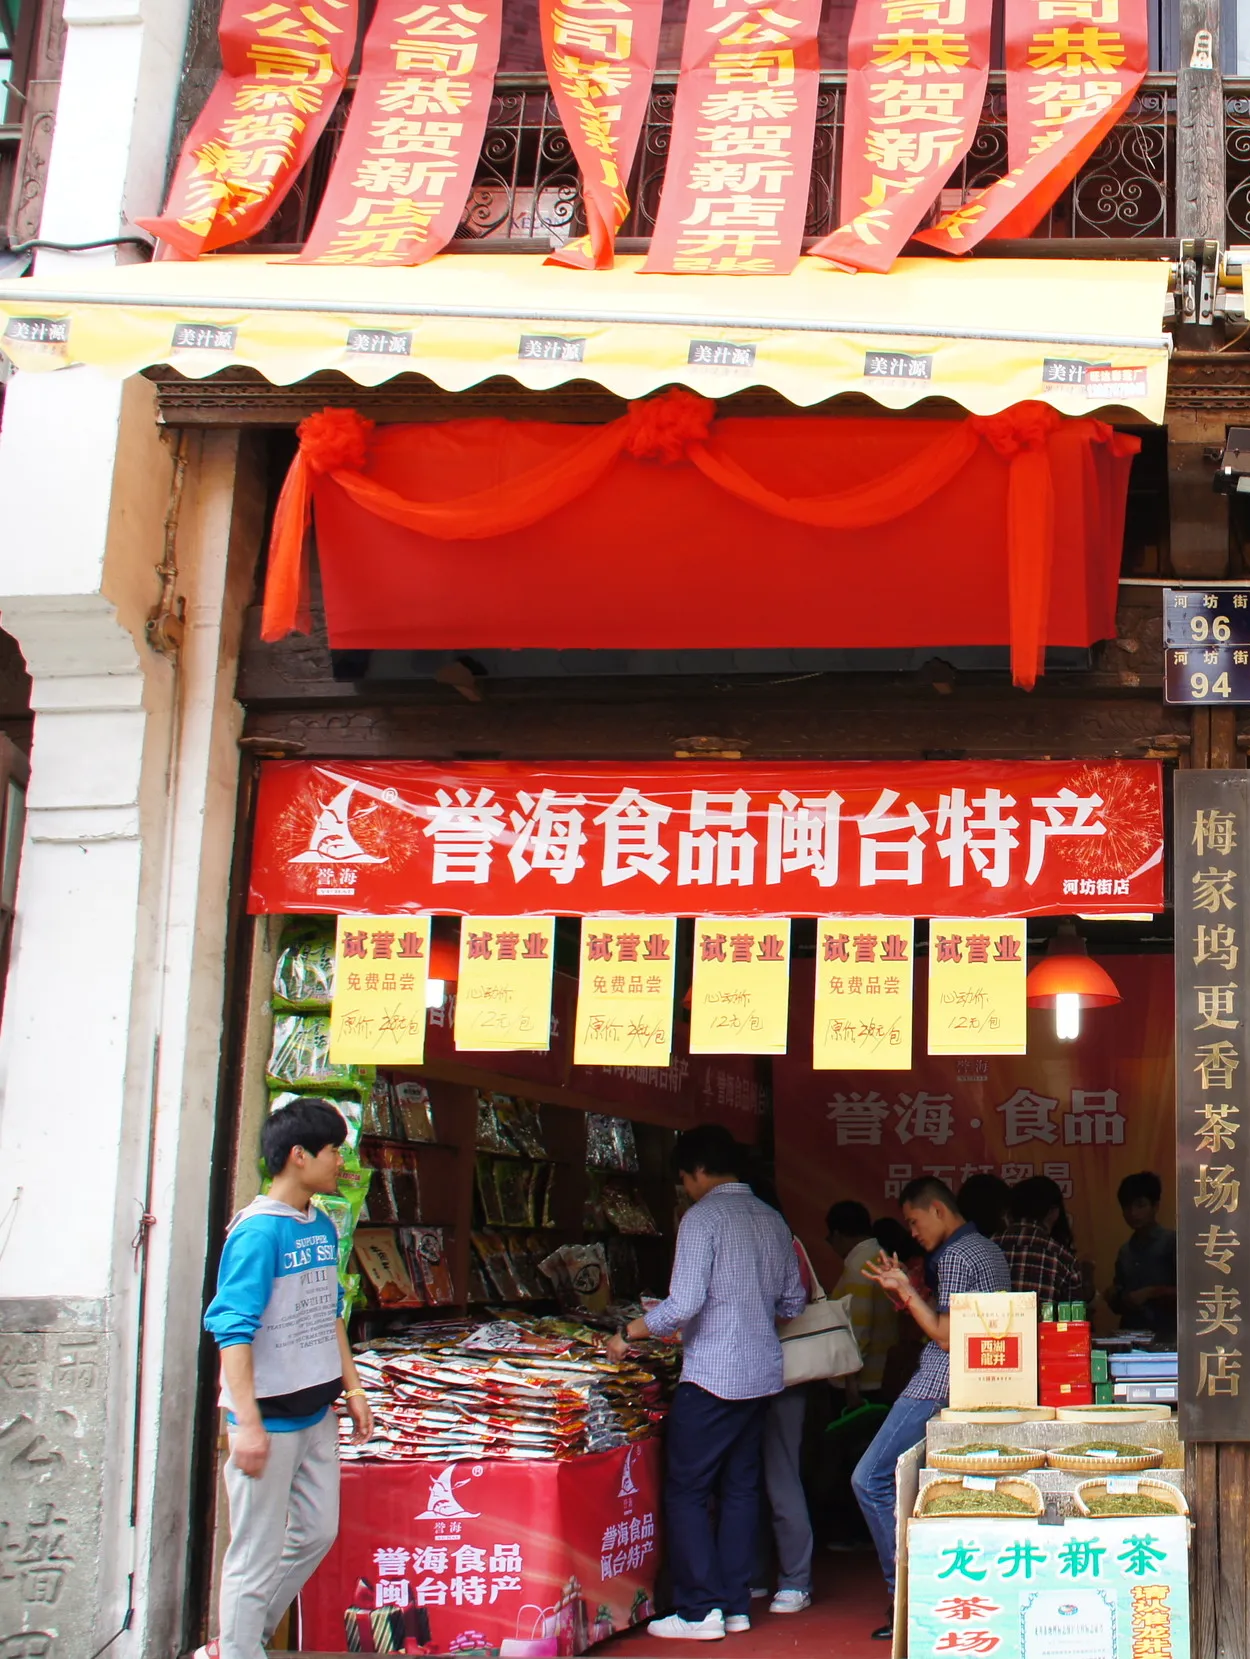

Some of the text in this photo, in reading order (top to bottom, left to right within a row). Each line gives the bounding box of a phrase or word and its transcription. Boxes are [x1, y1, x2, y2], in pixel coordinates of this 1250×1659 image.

[673, 0, 802, 271] 公司恭贺新店开张
[13, 322, 66, 341] 美汁源
[177, 328, 233, 348] 美汁源
[353, 332, 410, 355] 美汁源
[525, 338, 582, 361] 美汁源
[694, 345, 753, 367] 美汁源
[871, 356, 930, 379] 美汁源
[1048, 363, 1087, 383] 美汁
[1174, 594, 1248, 609] 河坊街
[1190, 615, 1231, 642] 96
[1173, 651, 1249, 665] 河坊街
[1190, 671, 1231, 698] 94
[422, 786, 1107, 888] 誉海食品闽台特产
[1062, 878, 1130, 896] 河坊街店
[342, 931, 424, 959] 试营业
[467, 932, 549, 960] 试营业
[586, 933, 670, 962] 试营业
[700, 933, 785, 962] 试营业
[822, 934, 909, 963] 试营业
[935, 934, 1022, 963] 试营业
[347, 972, 415, 991] 免费品尝
[593, 975, 662, 993] 免费品尝
[829, 976, 900, 994] 免费品尝
[1192, 808, 1242, 1397] 梅家坞更香茶场专卖店
[981, 1340, 1005, 1353] 西湖
[601, 1512, 654, 1553] 誉海食品
[373, 1544, 523, 1576] 誉海食品
[601, 1541, 653, 1581] 闽台特产
[937, 1533, 1168, 1581] 龙井新茶
[374, 1575, 523, 1608] 闽台特产
[1131, 1584, 1172, 1659] 请认准龙井
